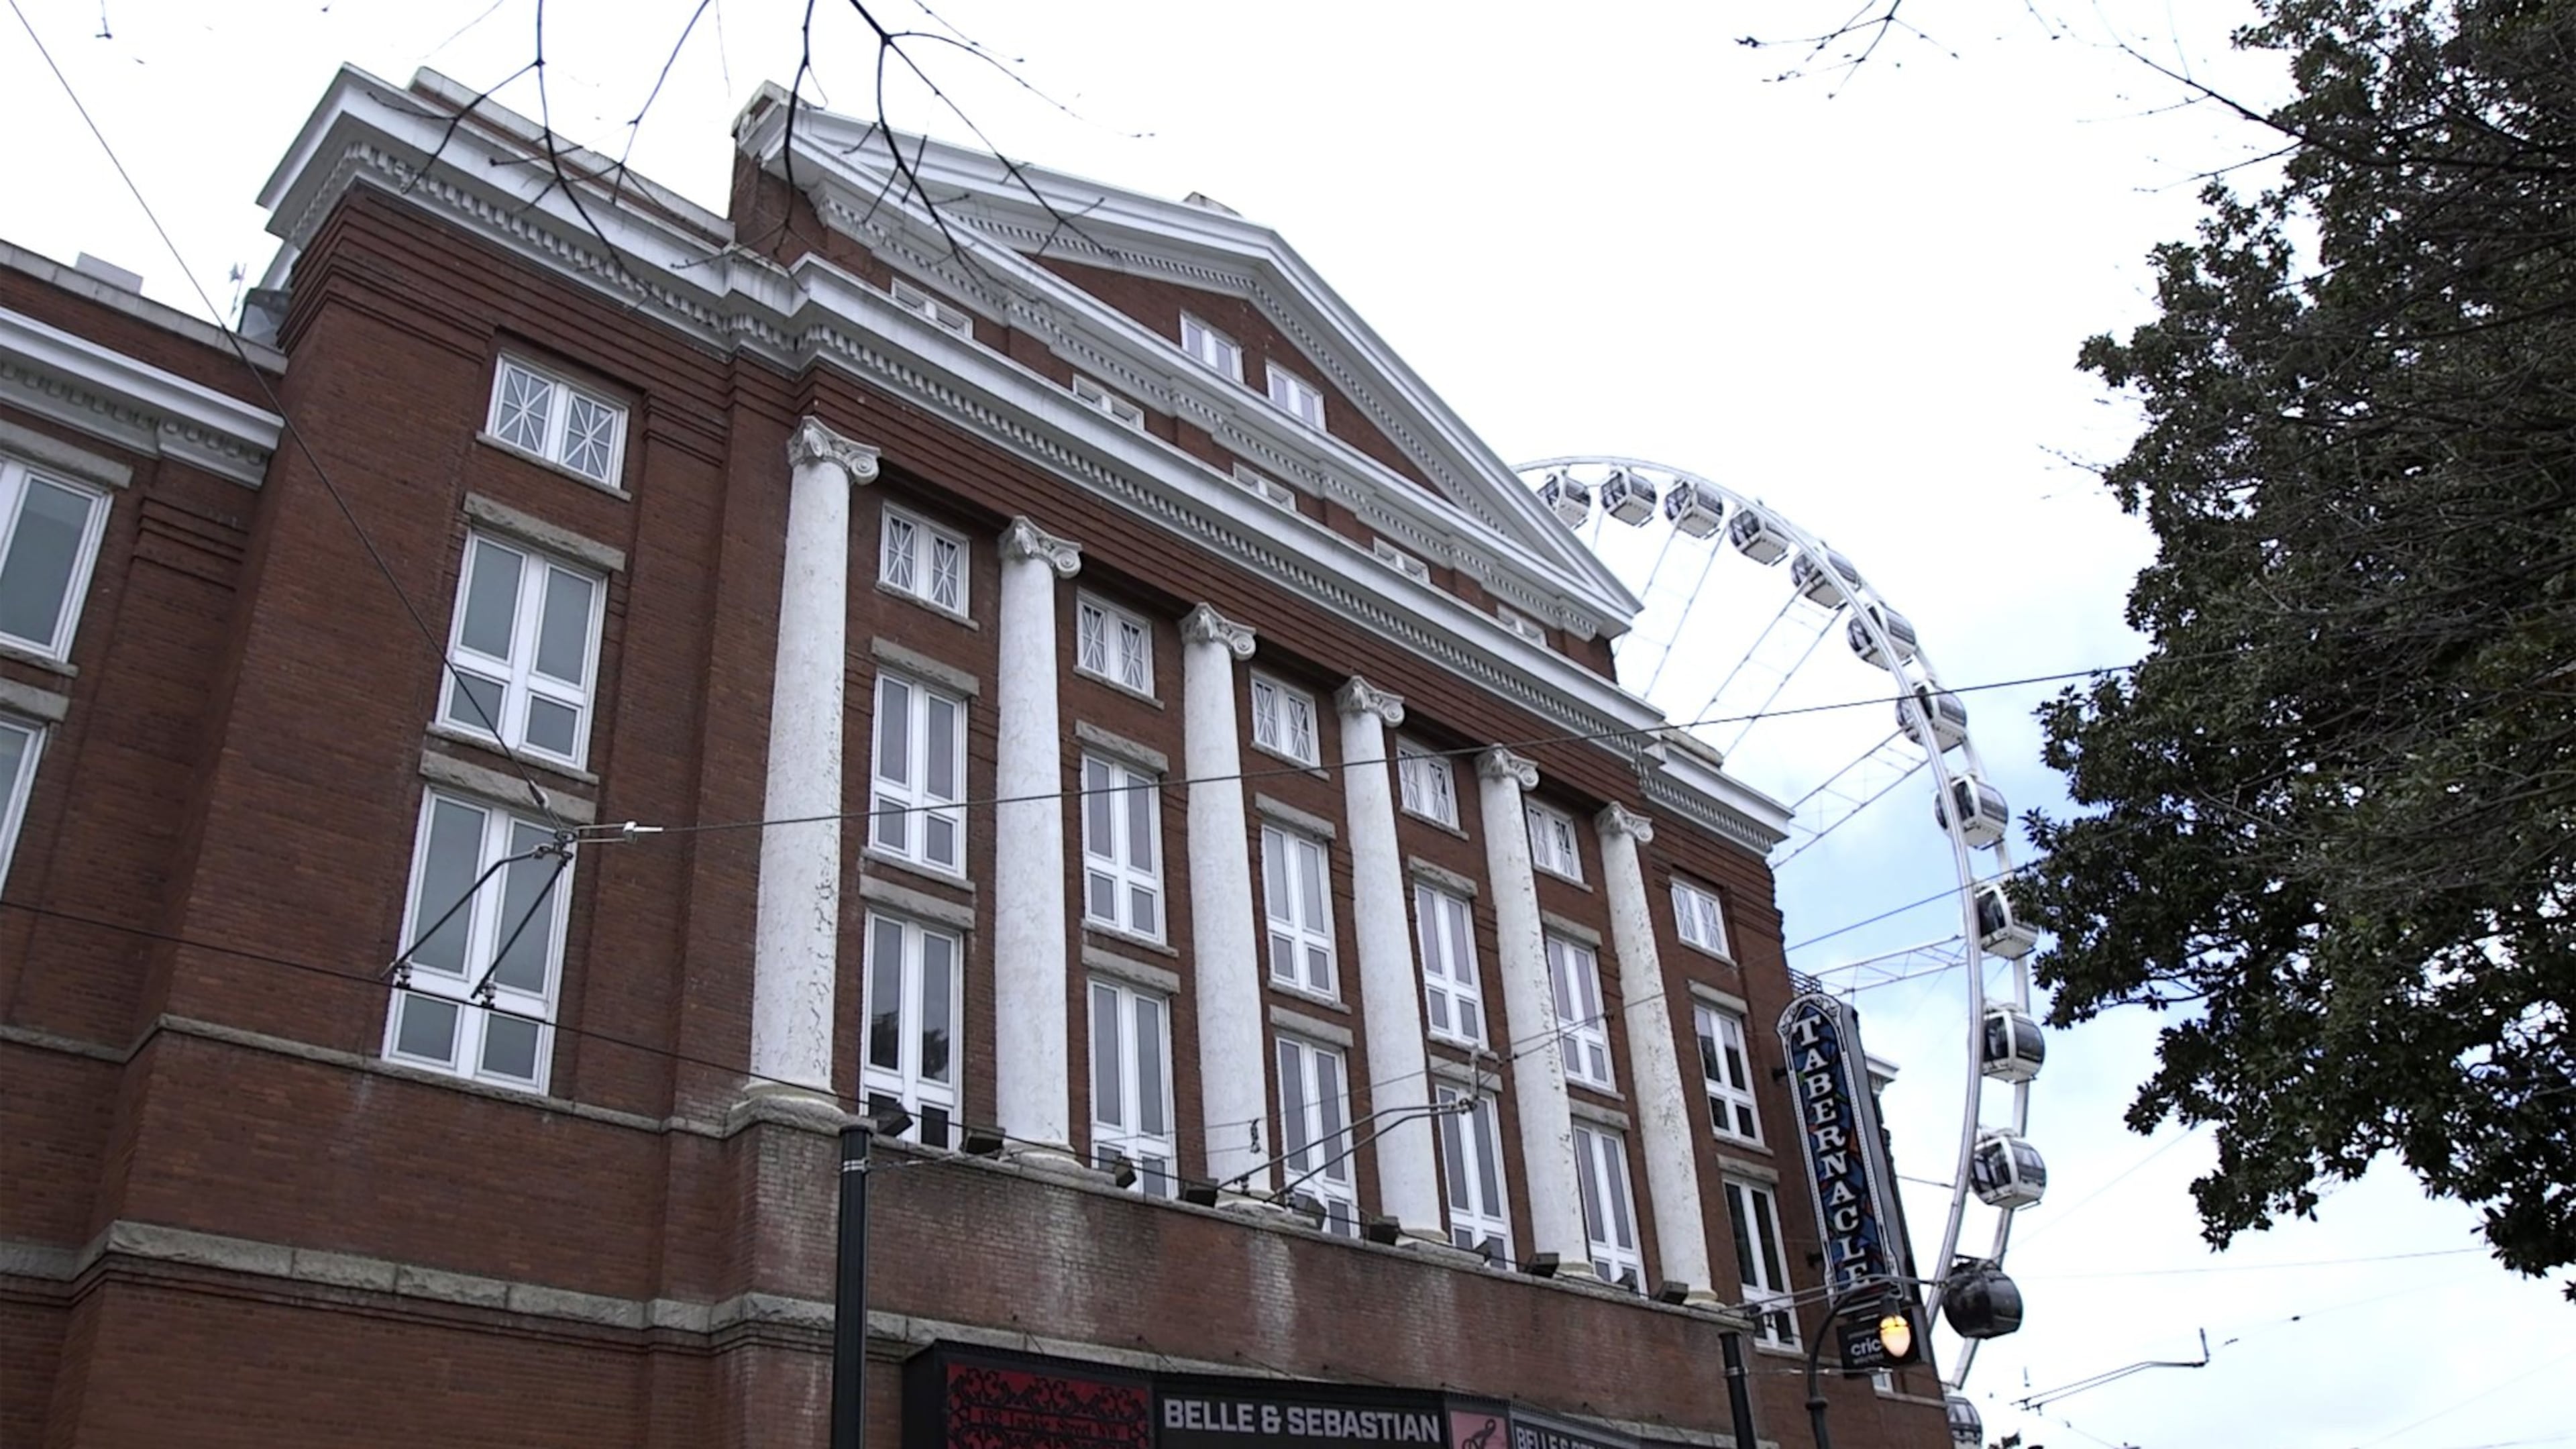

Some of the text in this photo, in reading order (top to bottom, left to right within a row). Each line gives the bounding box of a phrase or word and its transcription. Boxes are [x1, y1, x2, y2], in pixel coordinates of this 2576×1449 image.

[1792, 1016, 1870, 1290] TABERNACLE
[1850, 1336, 1884, 1356] cric
[1164, 1399, 1441, 1443] BELLE & SEBASTIAN
